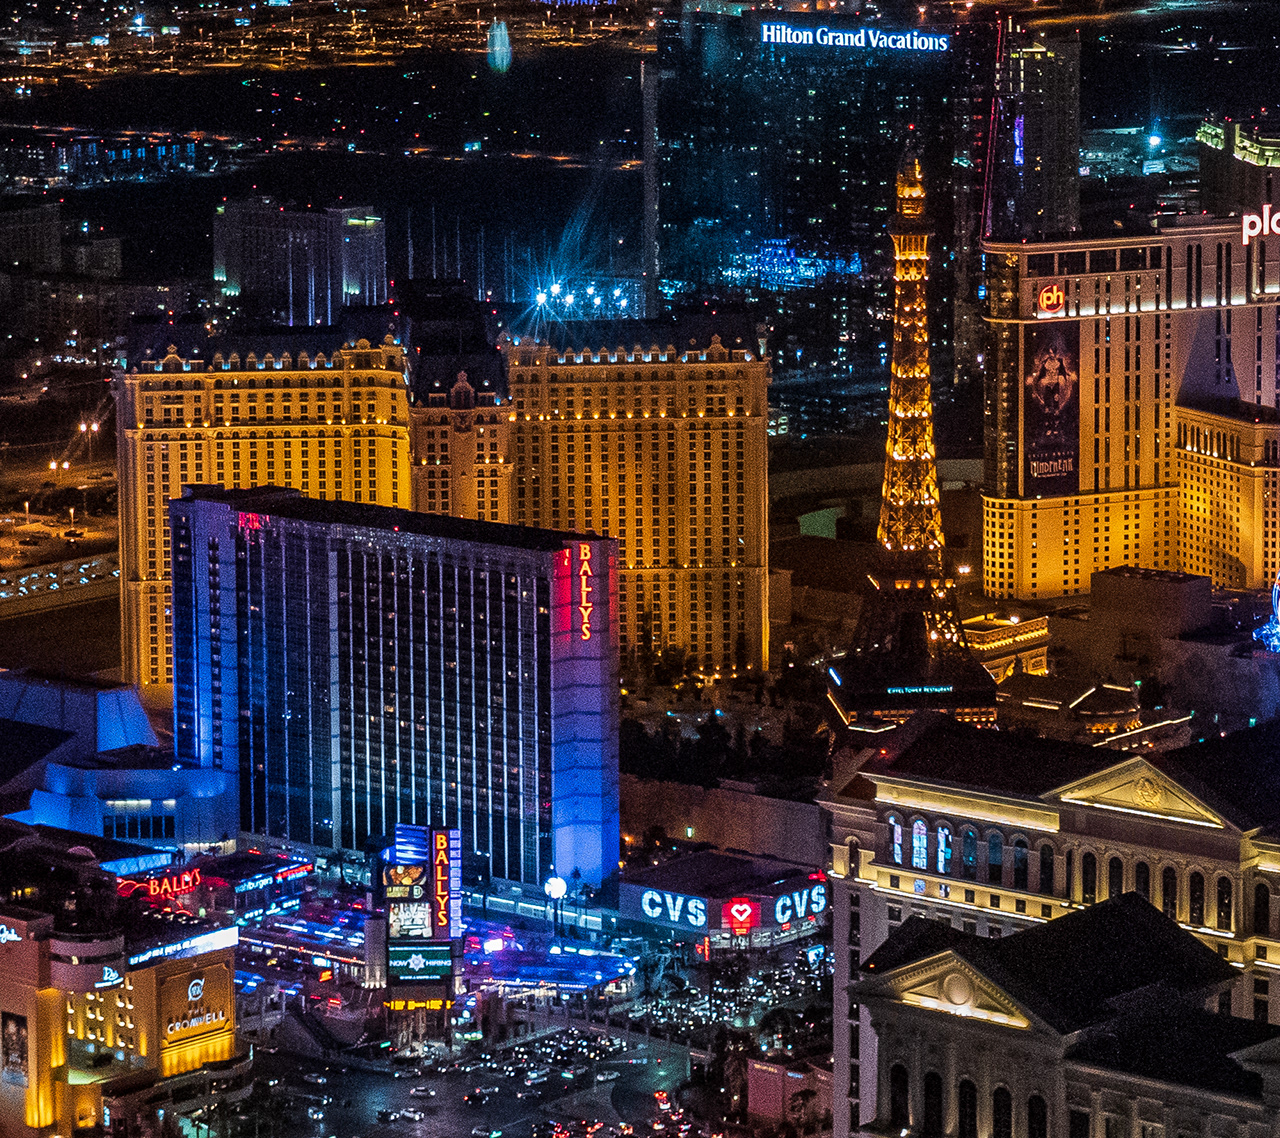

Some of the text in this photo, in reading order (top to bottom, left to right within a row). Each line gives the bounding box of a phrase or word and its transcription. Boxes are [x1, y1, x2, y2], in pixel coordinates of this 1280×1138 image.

[762, 25, 947, 51] Hilton Grand Vacations
[579, 543, 593, 640] BALLYS
[149, 868, 200, 899] BALLYS
[435, 834, 449, 926] BALLYS
[641, 889, 707, 927] CVS
[775, 885, 826, 924] CVS
[167, 1010, 225, 1034] CROMWELL
